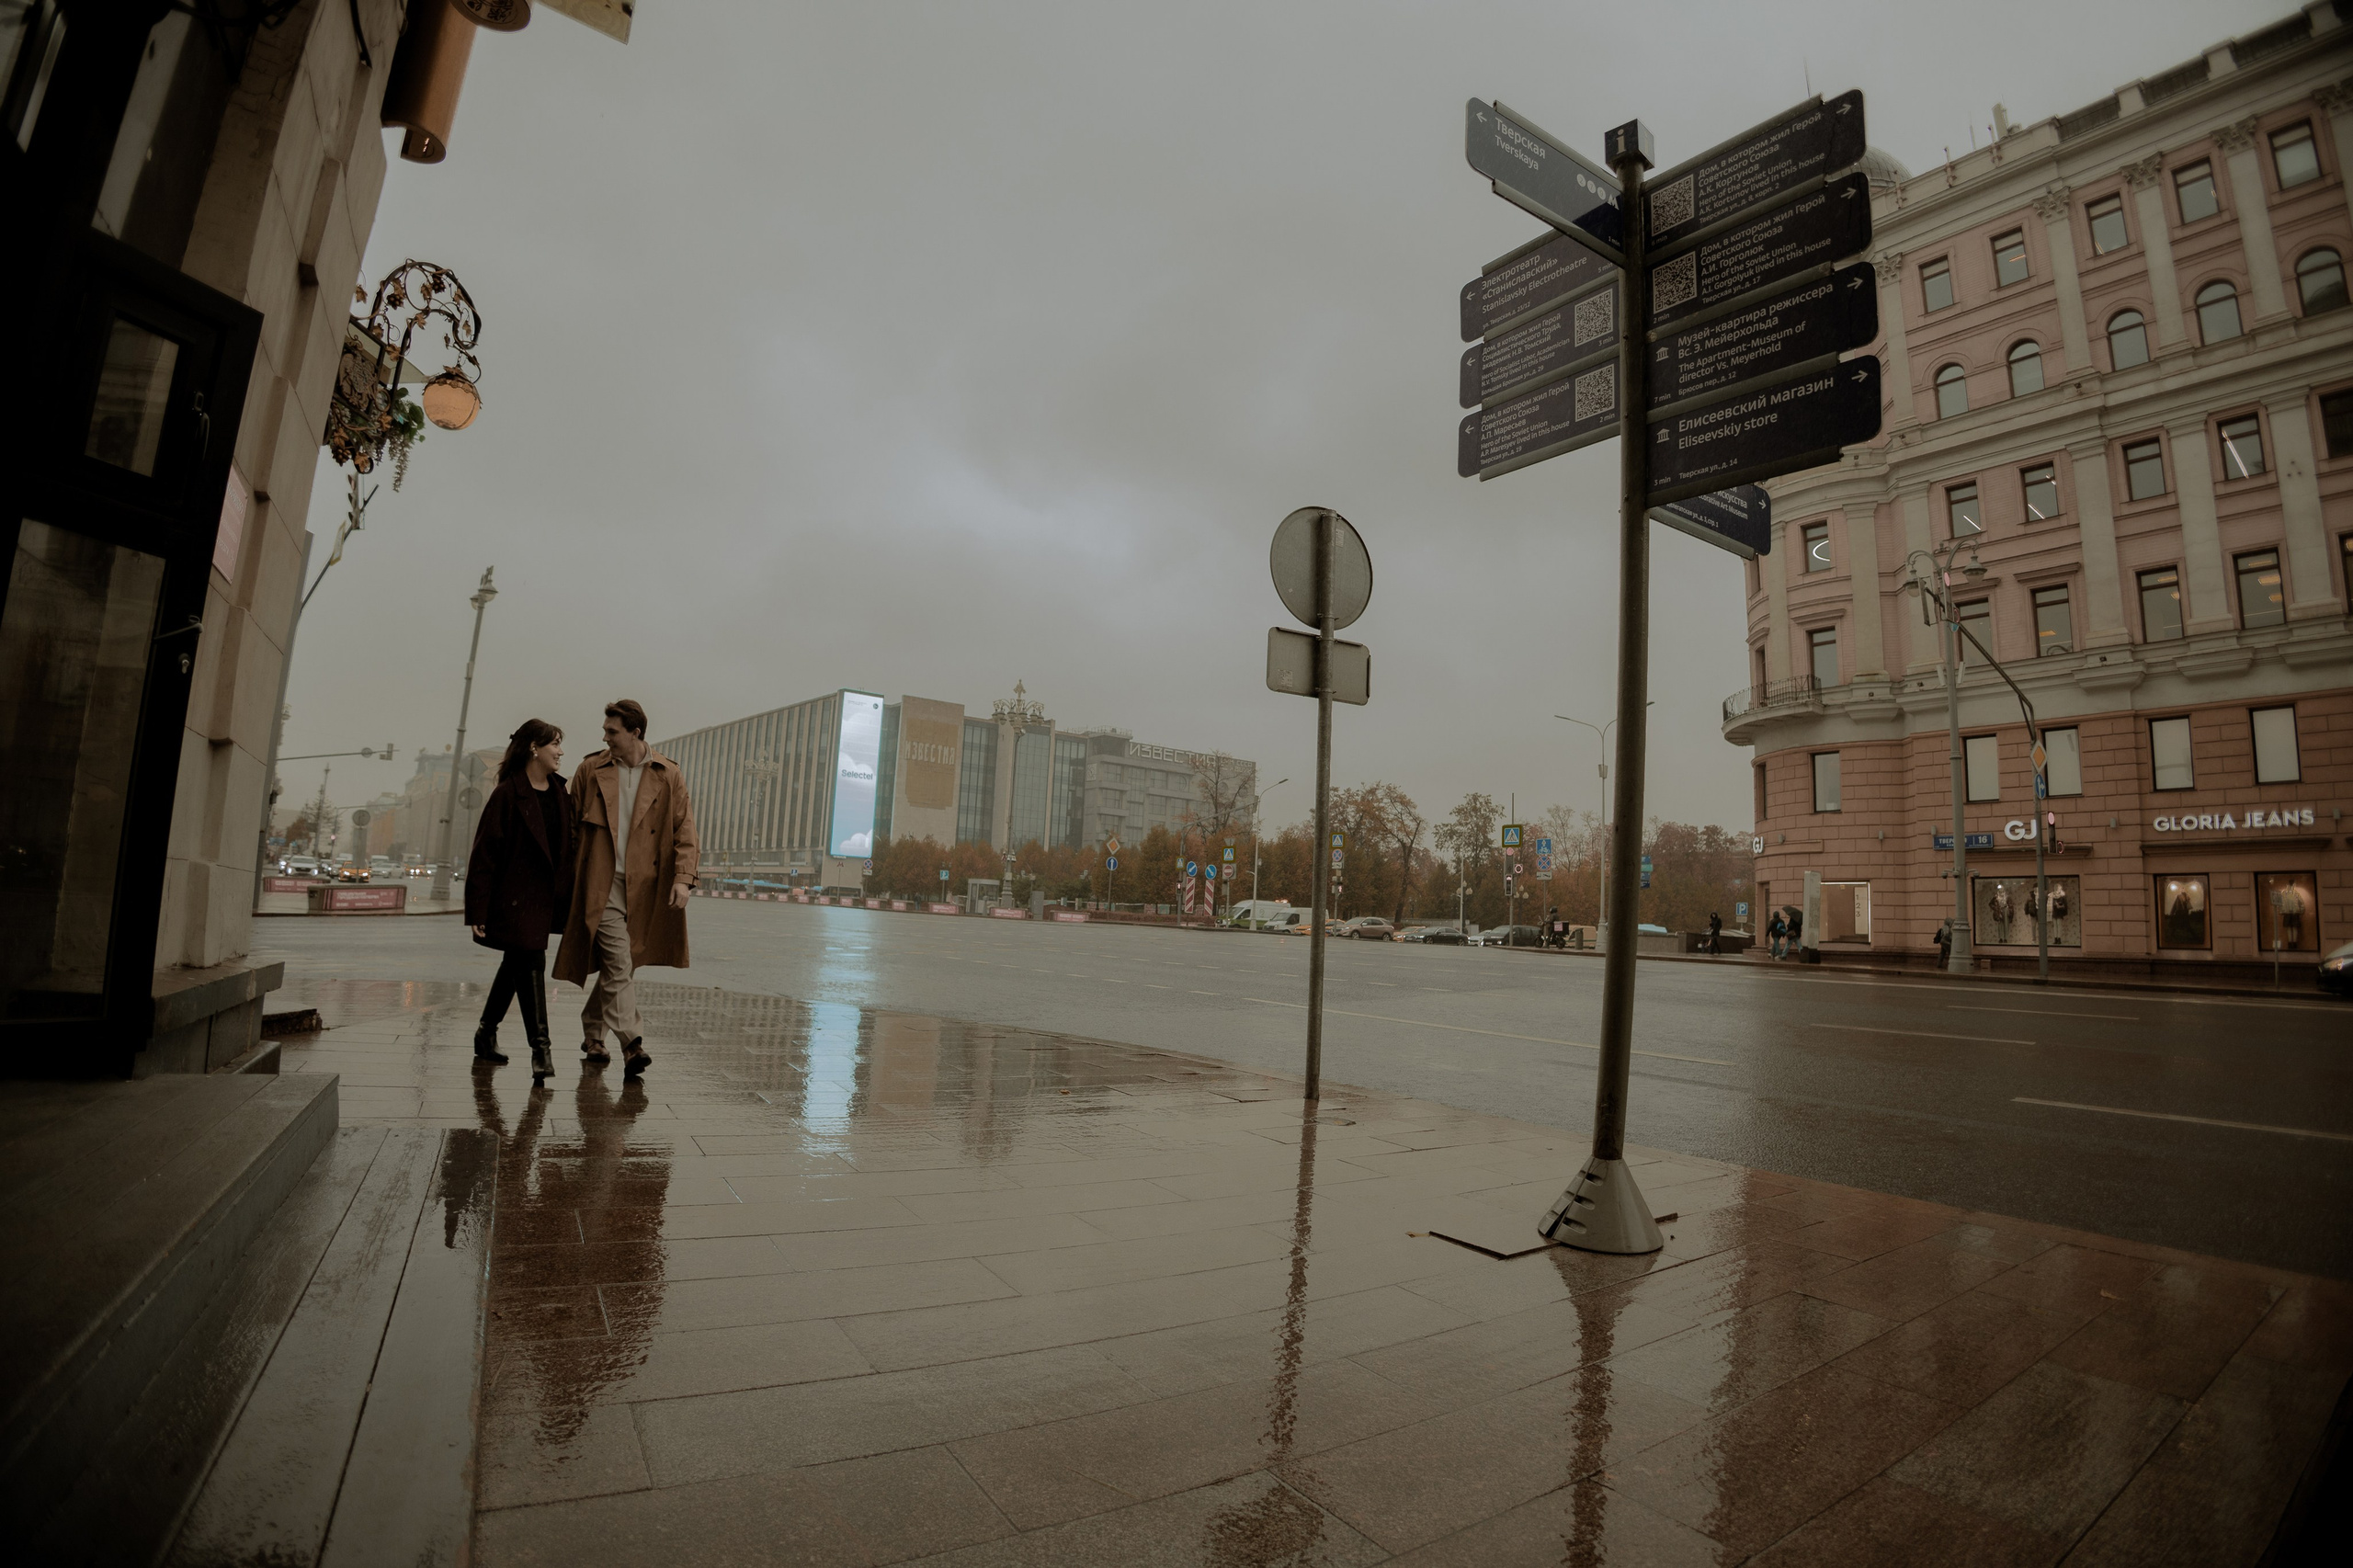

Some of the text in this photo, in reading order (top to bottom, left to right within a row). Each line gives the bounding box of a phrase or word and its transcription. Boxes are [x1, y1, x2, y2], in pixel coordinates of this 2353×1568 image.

[1495, 117, 1546, 159] Тверская
[1495, 135, 1539, 171] Tverskaya
[1698, 164, 1719, 179] Дом,
[1727, 139, 1768, 164] котором
[1769, 128, 1790, 143] жил
[1791, 111, 1821, 132] Герой
[1698, 143, 1779, 187] Советского Союза
[1698, 163, 1759, 198] А.К. Кортунов
[1699, 159, 1791, 207] Hero of the Soviet Union
[1699, 153, 1824, 216] A.K. Kortunov lived in this house
[1699, 206, 1728, 223] Тверская
[1755, 187, 1773, 199] корп.
[1699, 242, 1722, 257] Дом,
[1730, 219, 1771, 243] котором
[1772, 210, 1793, 223] жил
[1795, 194, 1824, 214] Герой
[1700, 225, 1782, 266] Советского Союза
[1700, 244, 1764, 276] А.И. Горголюк
[1481, 255, 1540, 290] Электротеатр
[1482, 257, 1558, 300] «Станиславский»
[1602, 261, 1613, 271] min
[1701, 242, 1796, 286] Hero of the Soviet Union
[1701, 237, 1831, 295] A.I. Gorgolyuk lived in this house
[1482, 256, 1586, 313] Stanislavsky Electrotheatre
[1701, 285, 1732, 303] Тверская
[1752, 275, 1760, 284] 17
[1489, 311, 1511, 324] Тверская,
[1658, 312, 1670, 323] min
[1677, 283, 1833, 347] Музей-квартира режиссера
[1603, 336, 1614, 345] min
[1677, 320, 1806, 372] The Apartment-Museum of
[1678, 314, 1779, 358] Вс. Э. Мейерхольда
[1678, 340, 1780, 383] director Vs. Meyerhold
[1659, 392, 1671, 401] min
[1677, 382, 1703, 395] Брюсов
[1704, 378, 1720, 387] пер.,
[1728, 370, 1735, 379] 12
[1604, 413, 1616, 422] min
[1678, 377, 1833, 432] Елисеевский магазин
[1678, 413, 1777, 449] Eliseevskiy store
[1659, 475, 1671, 484] min
[1678, 466, 1709, 479] Тверская
[1729, 458, 1737, 466] 14
[904, 741, 956, 766] ИЗВЕСТИЯ
[1130, 743, 1216, 767] ИЗВЕСТИЯ
[841, 769, 873, 780] Selectel
[2004, 819, 2037, 841] GJ
[2153, 809, 2314, 832] GLORIA JEANS
[1753, 836, 1764, 854] GJ
[1978, 835, 1987, 844] 16
